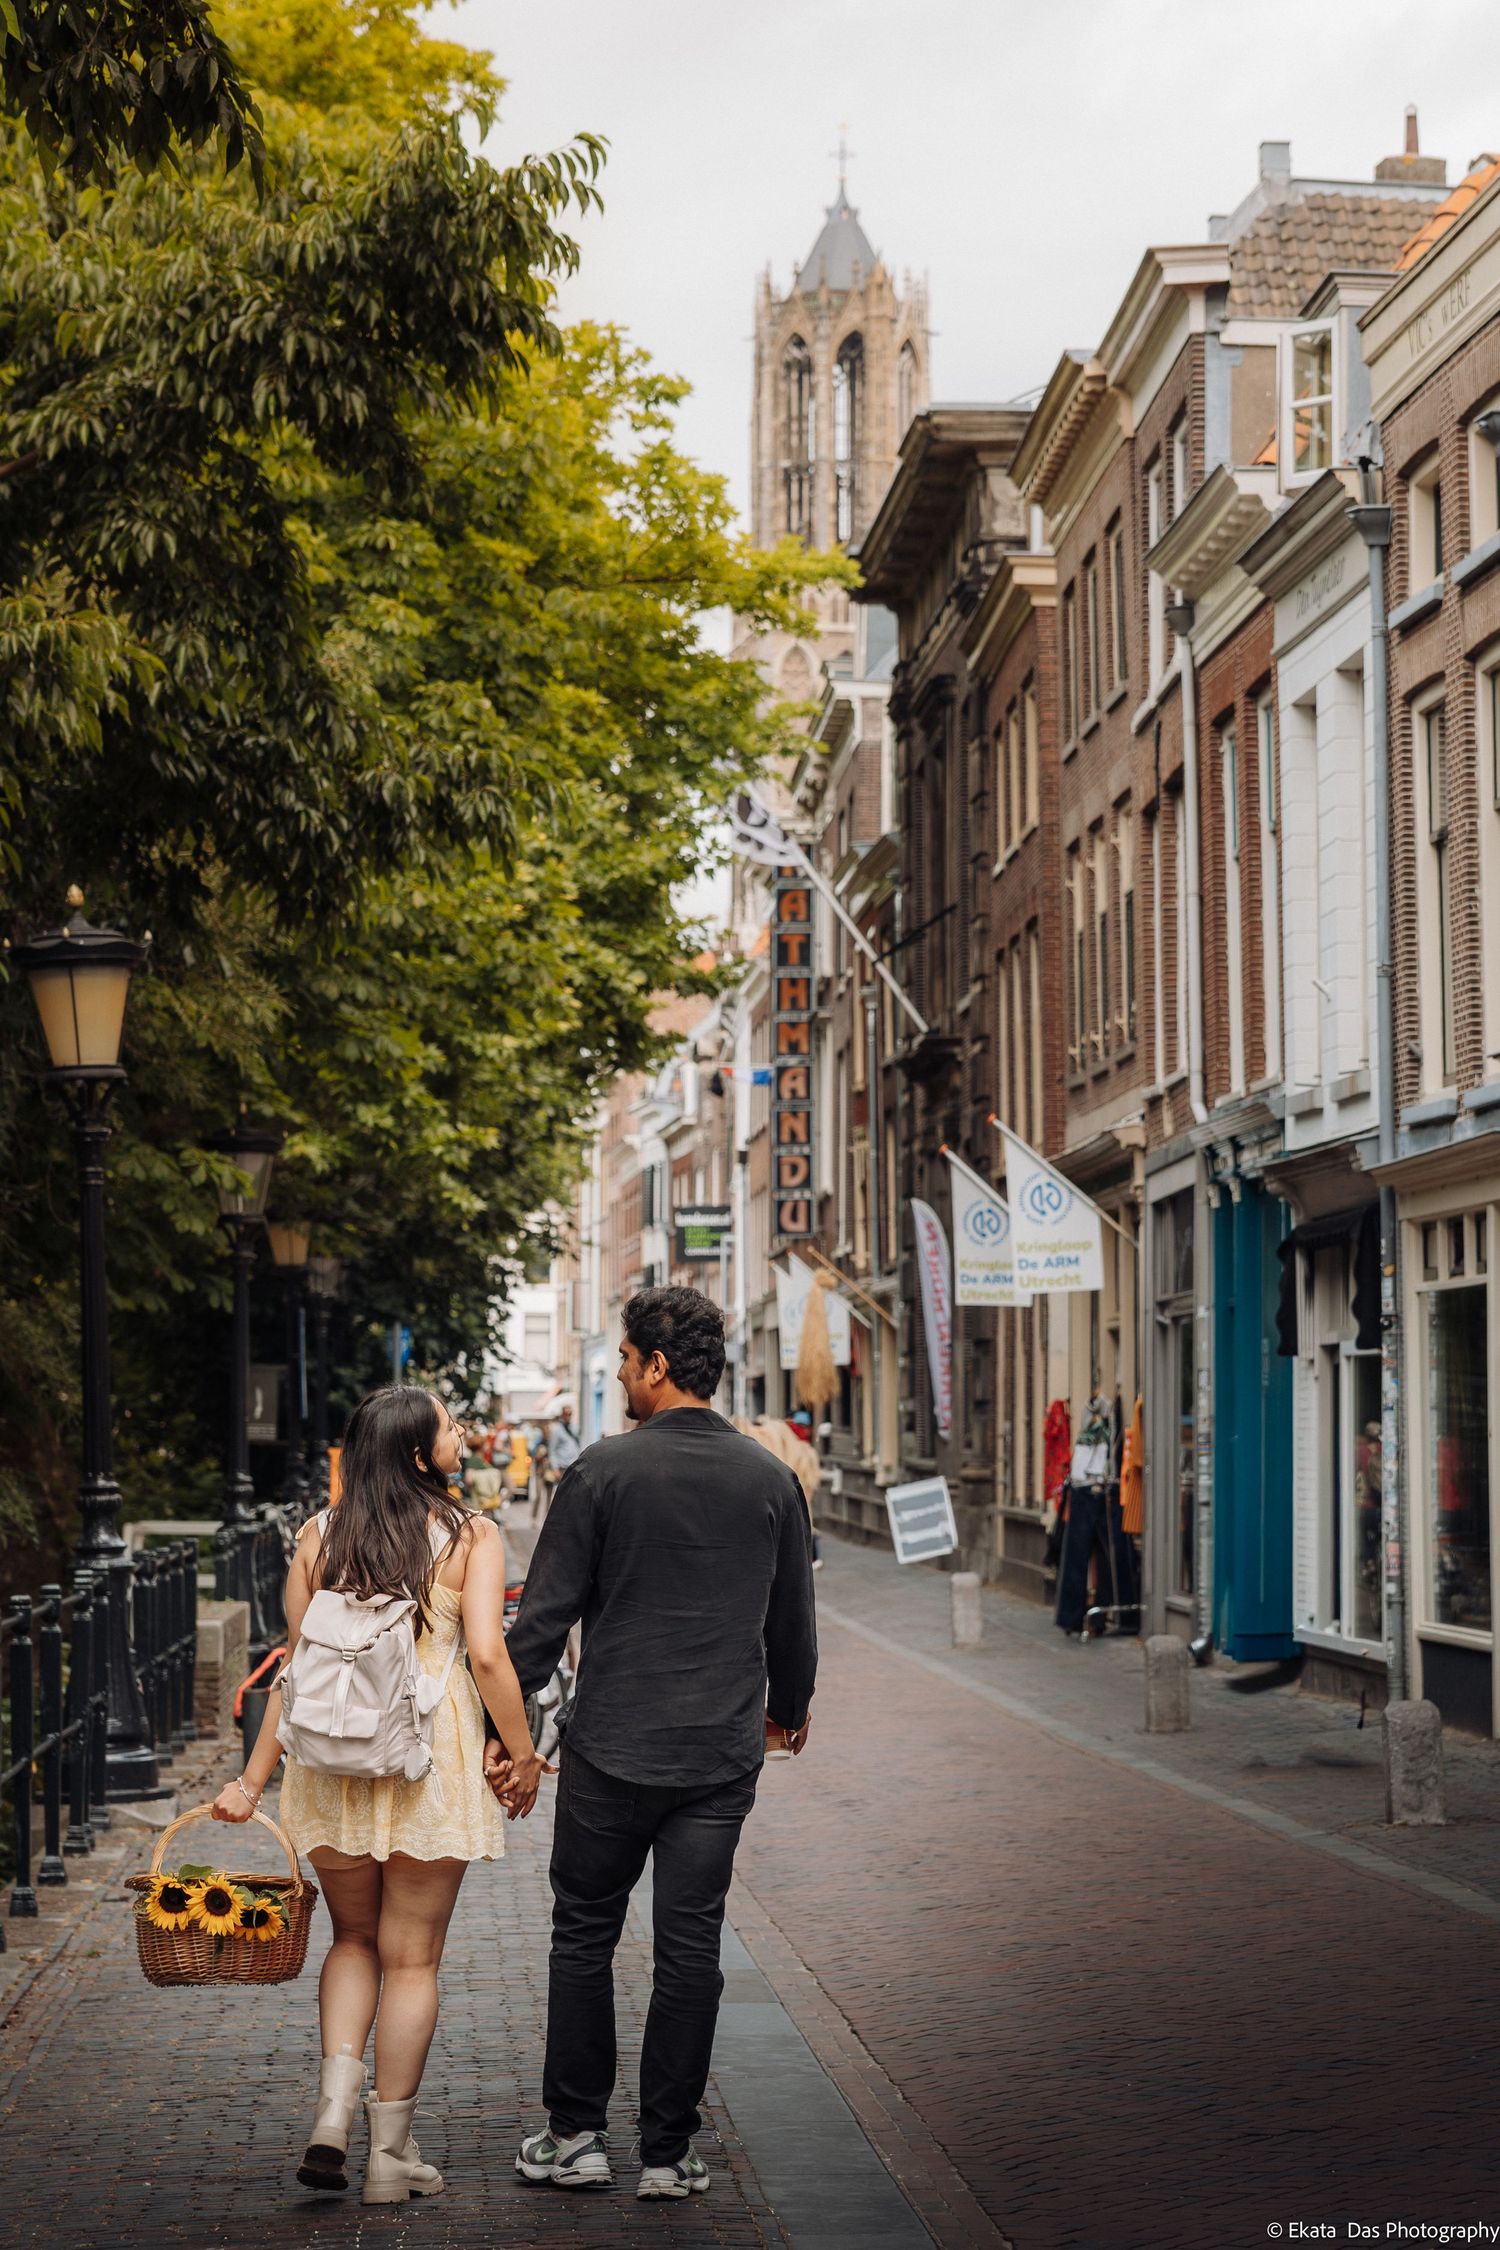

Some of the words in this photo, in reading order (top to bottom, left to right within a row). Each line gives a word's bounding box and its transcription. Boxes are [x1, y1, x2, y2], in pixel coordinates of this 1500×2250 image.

[778, 862, 810, 1233] ATHMANDU
[1016, 1240, 1092, 1253] Kringloop
[1018, 1258, 1038, 1271] De
[1044, 1255, 1080, 1268] ARM
[1019, 1273, 1082, 1288] Utrecht
